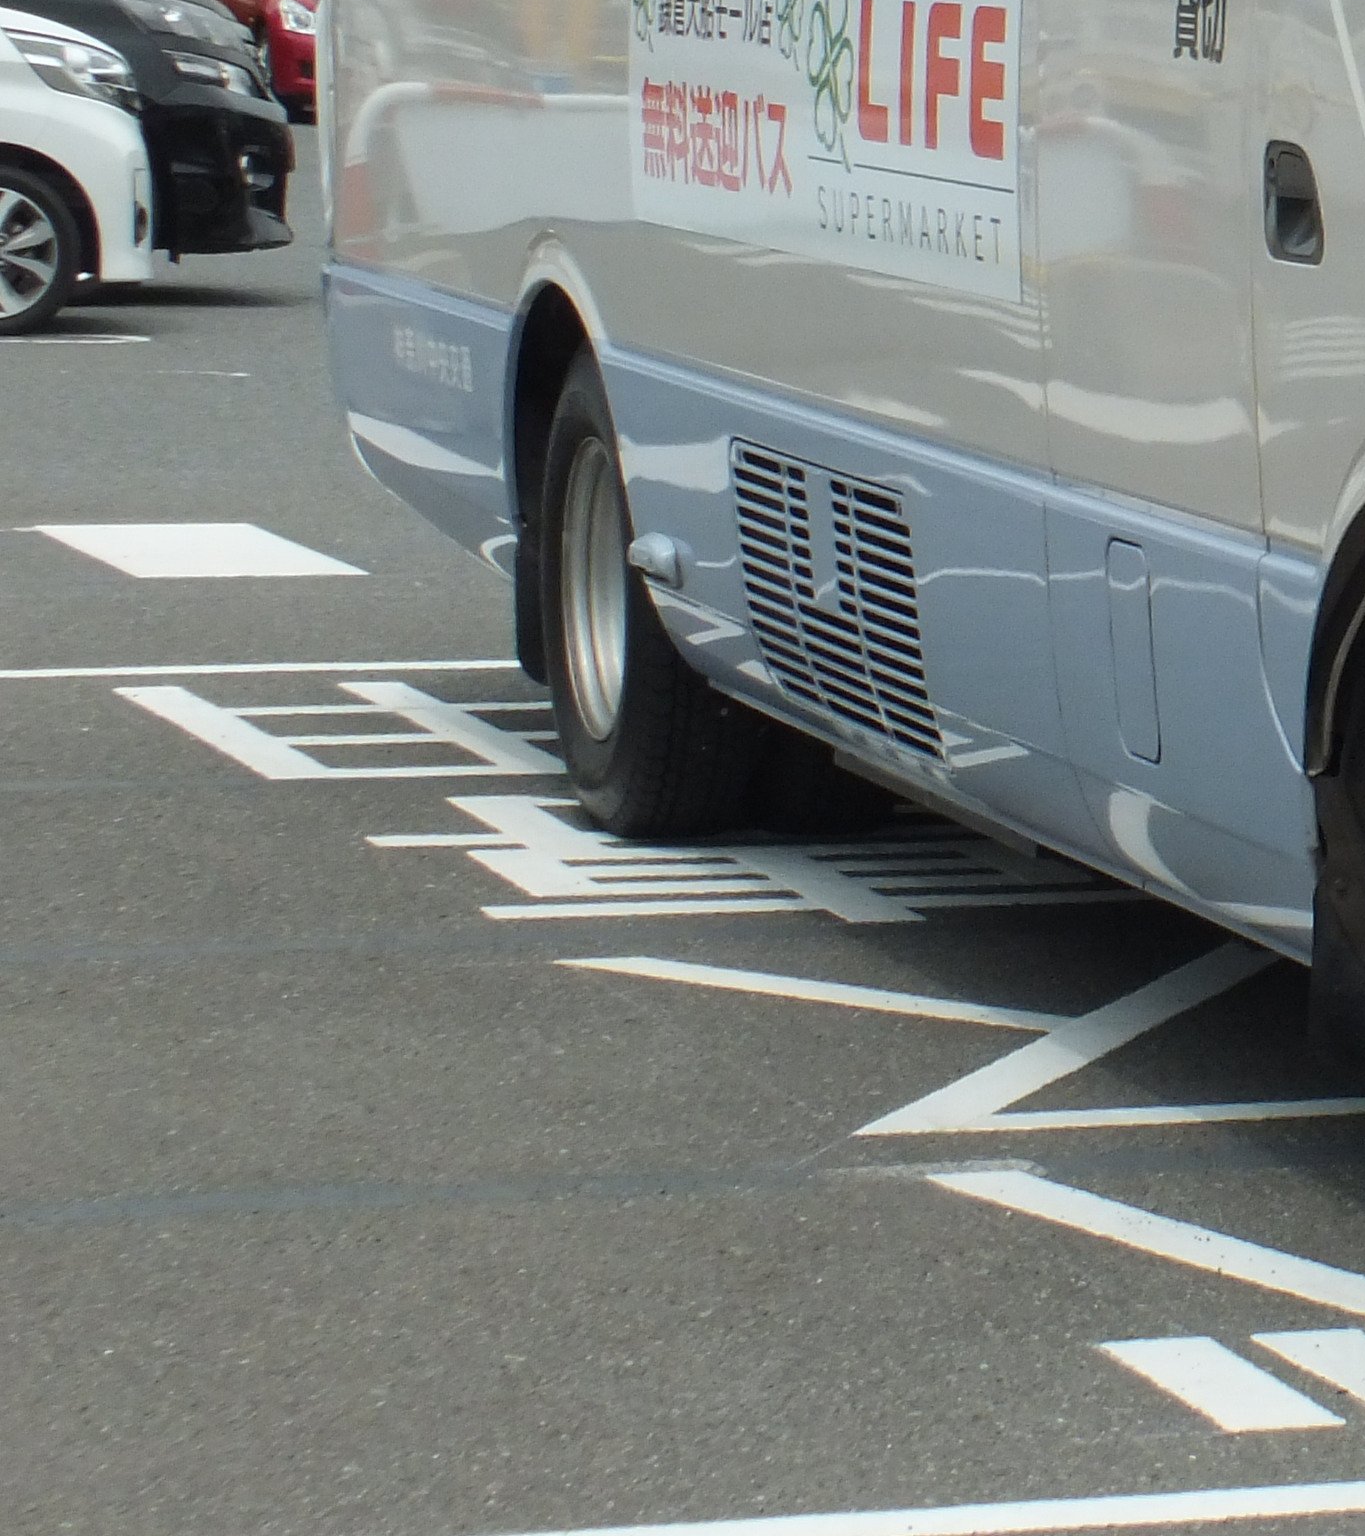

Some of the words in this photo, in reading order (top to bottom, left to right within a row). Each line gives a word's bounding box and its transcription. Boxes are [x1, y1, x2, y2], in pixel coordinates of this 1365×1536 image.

[641, 77, 793, 199] 無料送迎バス
[818, 186, 1002, 265] SUPERMARKET
